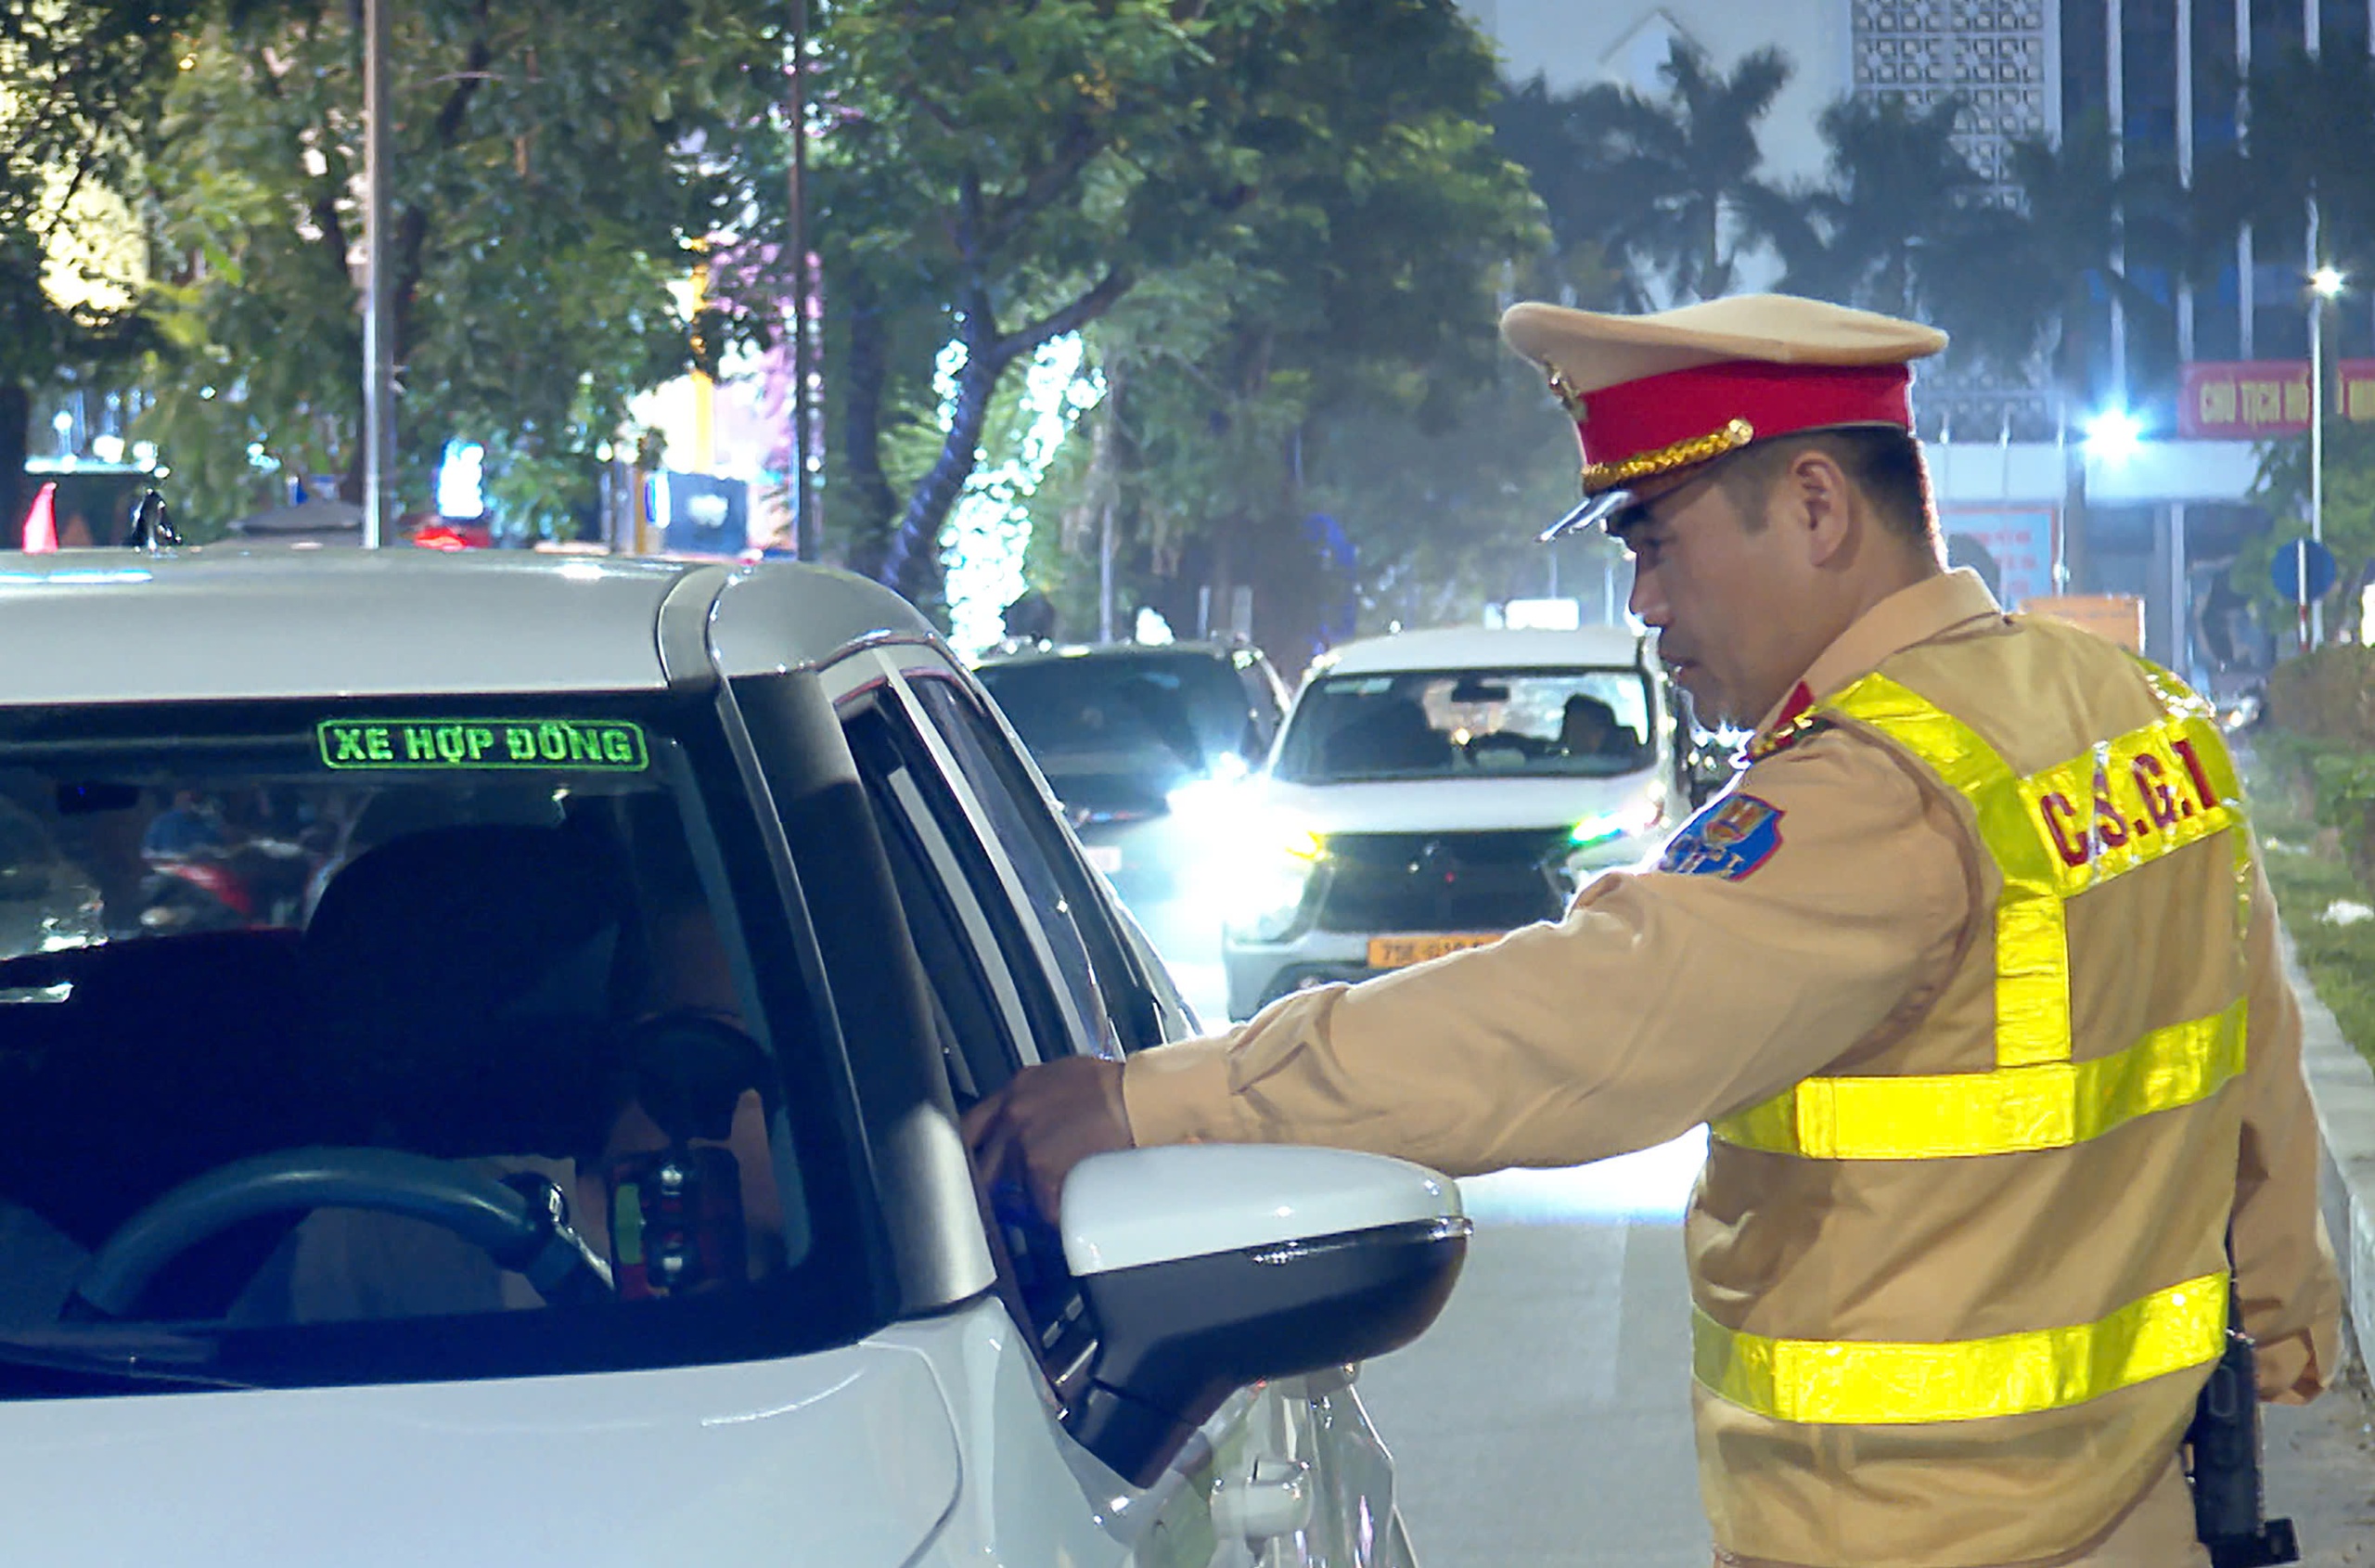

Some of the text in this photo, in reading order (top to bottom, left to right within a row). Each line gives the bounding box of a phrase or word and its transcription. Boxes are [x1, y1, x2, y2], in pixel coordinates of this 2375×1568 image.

[334, 721, 635, 764] XE HỢP ĐỒNG
